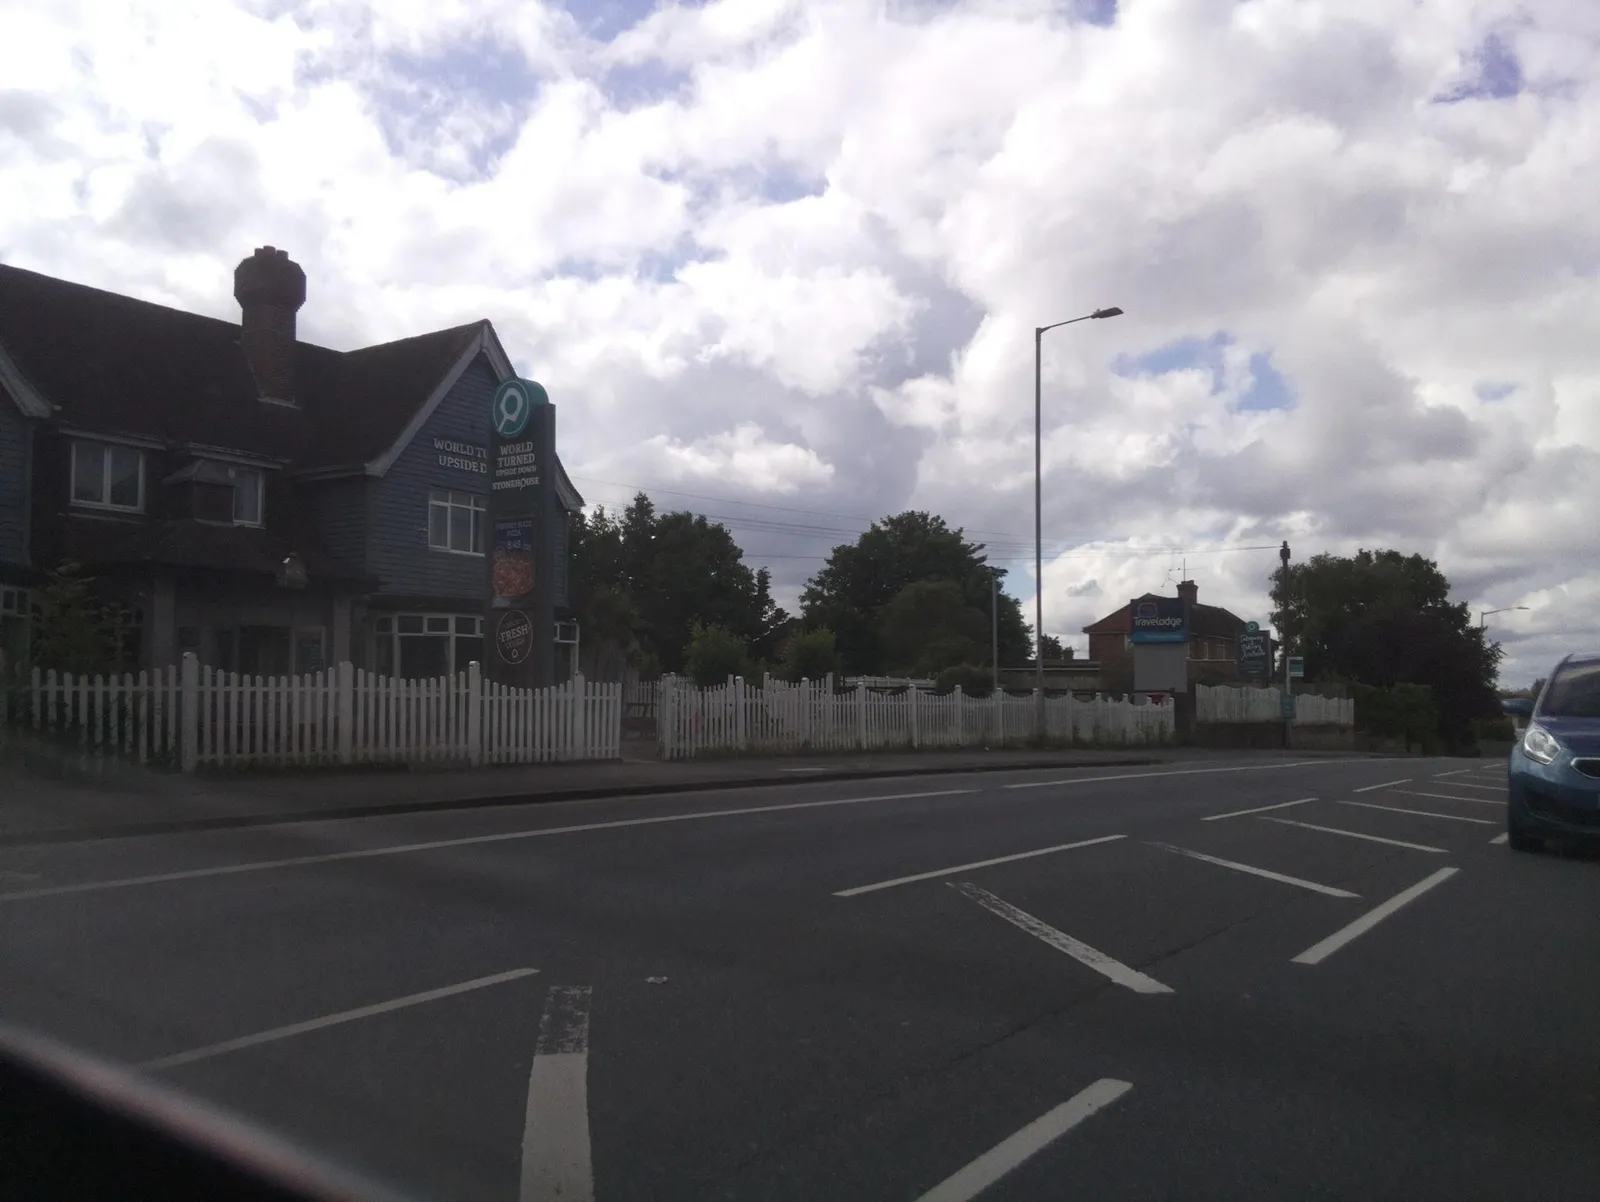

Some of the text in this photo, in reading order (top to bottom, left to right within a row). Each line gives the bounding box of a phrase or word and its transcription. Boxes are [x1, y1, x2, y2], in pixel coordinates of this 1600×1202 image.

[434, 438, 473, 456] WORLD
[499, 441, 533, 455] WORLD
[438, 455, 477, 472] UPSIDE
[497, 453, 535, 468] TURNED
[495, 465, 537, 477] UPSIDE DOWN
[492, 476, 540, 491] STONEHOUSE
[1133, 616, 1182, 627] Travelodge
[500, 624, 528, 642] FRESH
